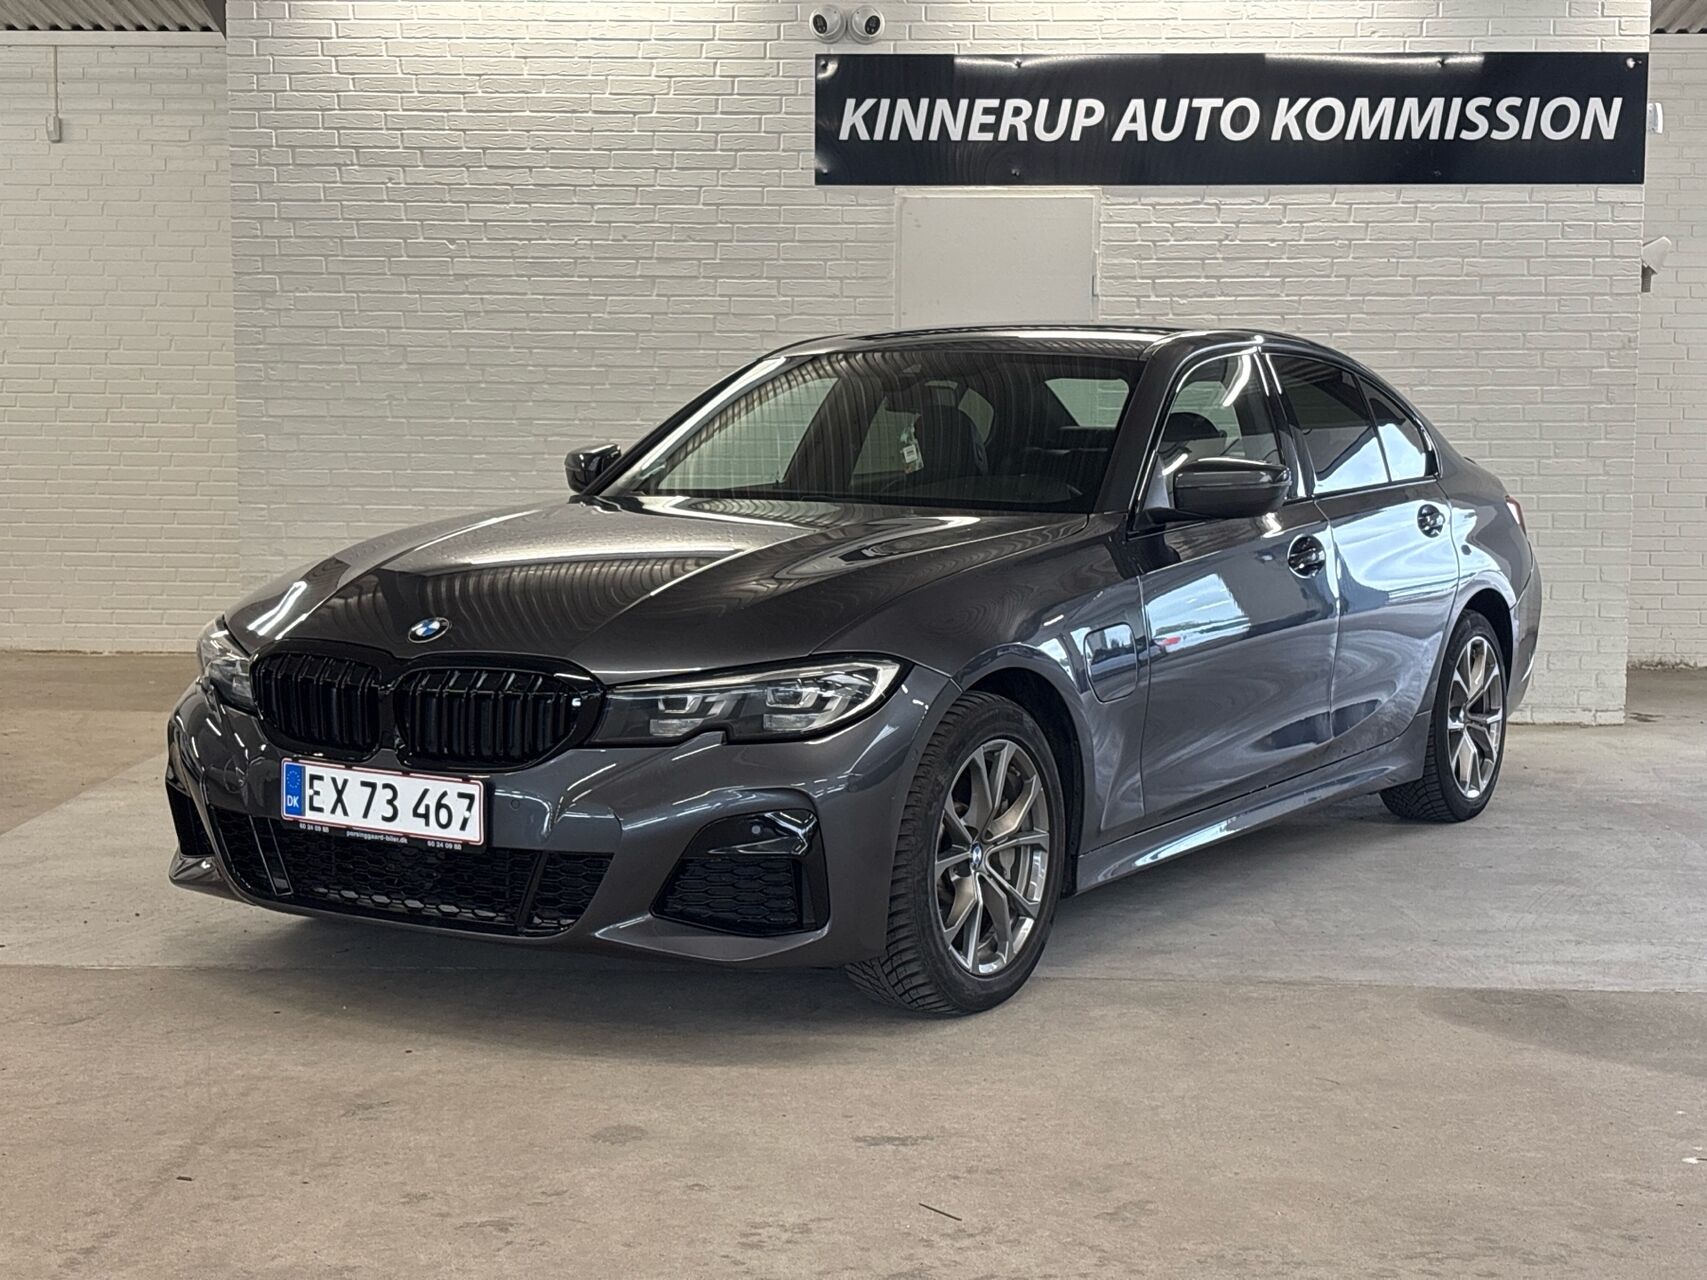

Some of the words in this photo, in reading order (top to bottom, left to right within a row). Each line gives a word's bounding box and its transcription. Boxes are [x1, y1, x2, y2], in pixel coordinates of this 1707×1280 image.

[839, 97, 1105, 142] KINNERUP
[1112, 97, 1261, 142] AUTO
[1271, 97, 1623, 142] KOMMISSION
[287, 795, 299, 808] DK
[308, 774, 349, 817] EX
[360, 781, 399, 823] 73
[412, 788, 475, 832] 467
